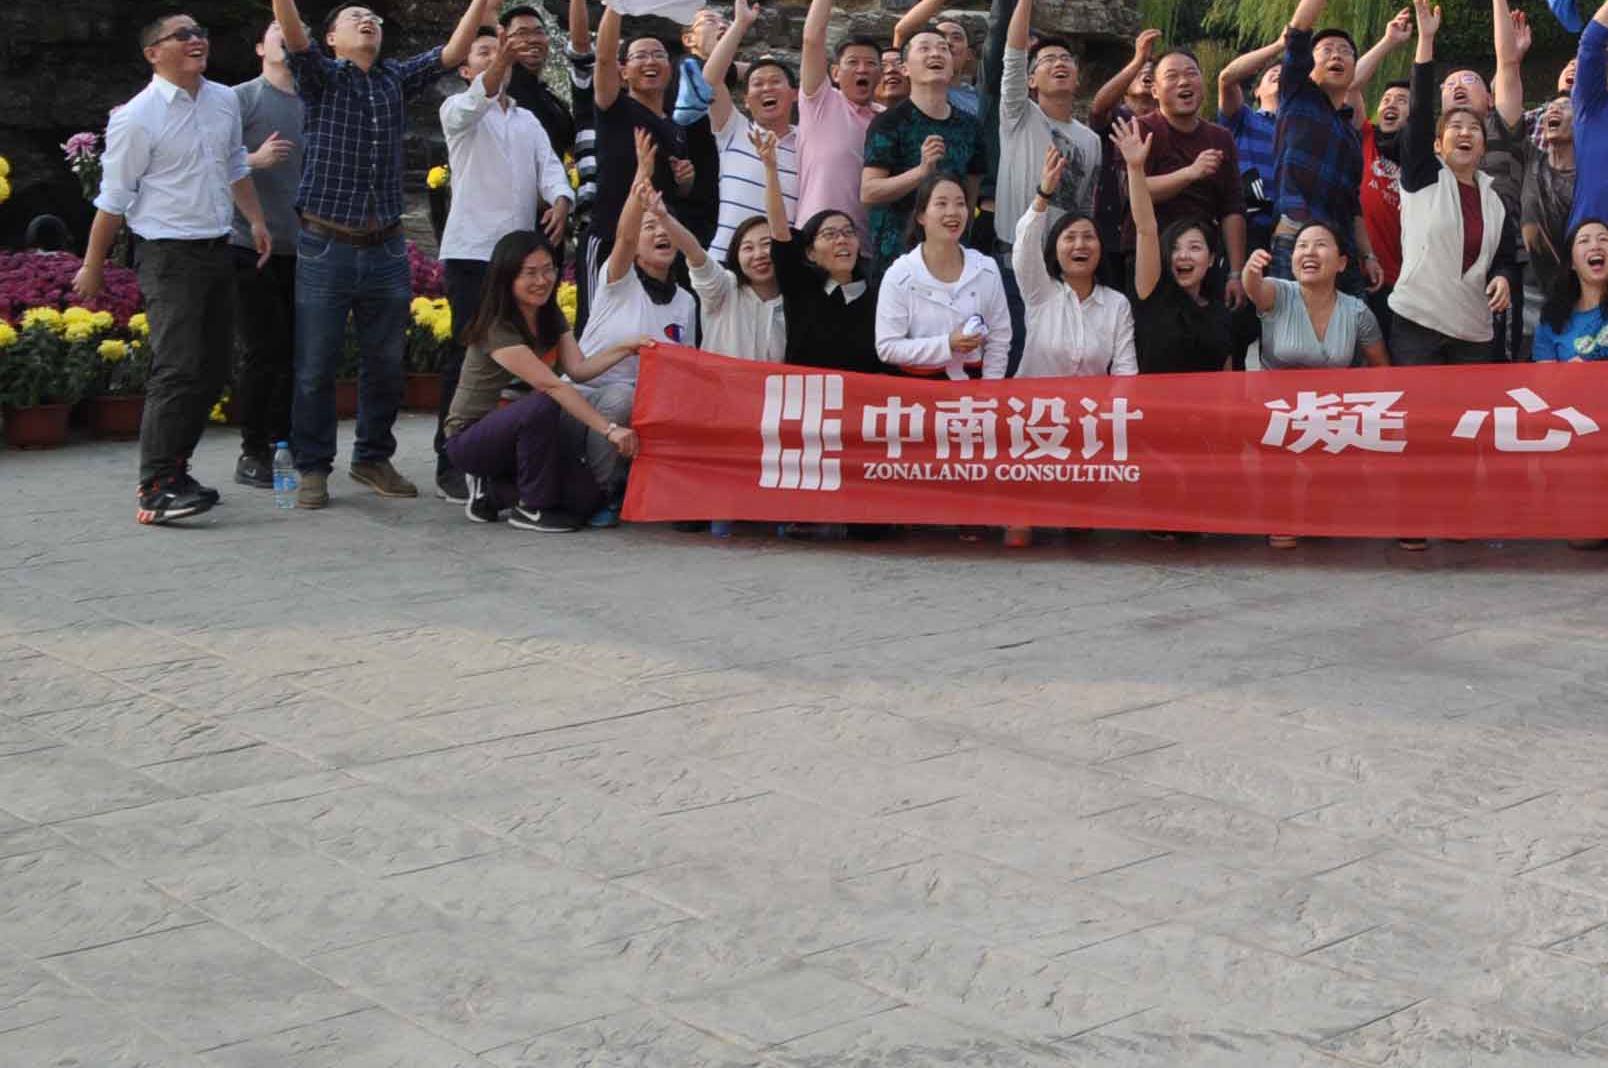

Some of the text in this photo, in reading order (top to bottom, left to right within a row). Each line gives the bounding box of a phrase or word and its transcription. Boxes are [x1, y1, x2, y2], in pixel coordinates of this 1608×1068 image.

[862, 396, 1143, 460] 中南设计
[863, 462, 1141, 483] ZONALAND CONSULTING
